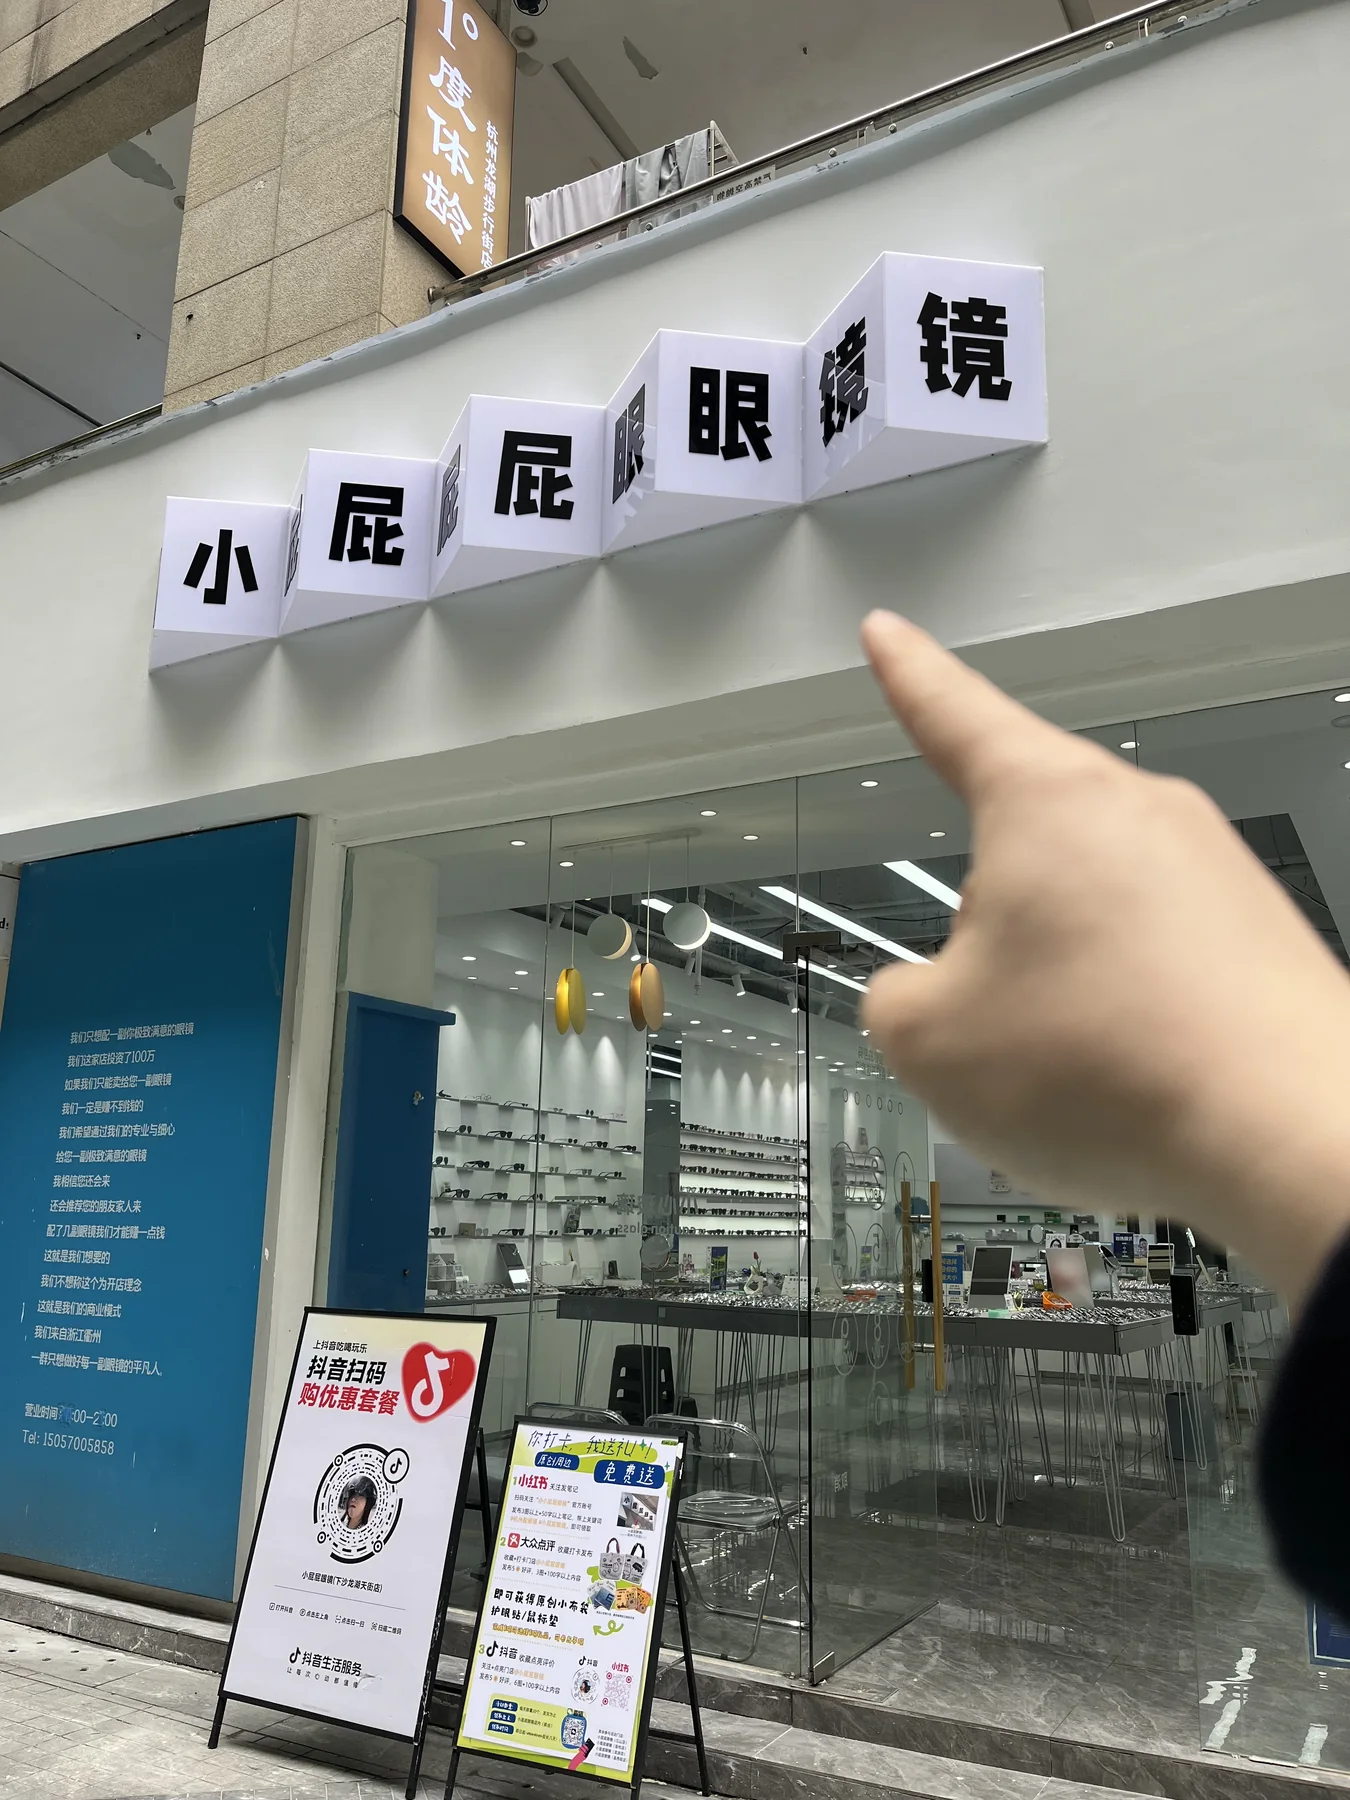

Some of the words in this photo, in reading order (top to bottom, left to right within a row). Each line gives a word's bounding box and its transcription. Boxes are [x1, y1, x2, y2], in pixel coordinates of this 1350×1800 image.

[67, 1049, 156, 1068] 我们这家店投资了100万
[63, 1072, 173, 1091] 如果我们只能卖给您一副眼镜
[61, 1098, 144, 1116] 我们一定是赚不到钱的
[58, 1122, 176, 1139] 我们希望通过我们的专业与细心
[55, 1148, 147, 1164] 给您一副极致满意的眼镜
[53, 1174, 111, 1188] 我相信您还会来
[49, 1199, 142, 1214] 还会推荐您的朋友家人来
[46, 1223, 166, 1240] 配了几副眼镜我们才能赚一点钱
[43, 1249, 111, 1265] 这就是我们想要的
[40, 1274, 142, 1293] 我们不想称这个为开店理念
[37, 1300, 122, 1318] 这就是我们的商业模式
[34, 1325, 102, 1344] 我们来自浙江衢州
[313, 1340, 368, 1354] 上抖音吃喝玩乐
[306, 1355, 388, 1385] 抖音扫码
[298, 1383, 401, 1416] 购优惠套餐
[22, 1429, 40, 1445] Tel:
[43, 1432, 115, 1455] 15057005858
[537, 1454, 572, 1468] 原创周边
[603, 1461, 655, 1485] 免费送
[518, 1473, 549, 1490] 小红书
[549, 1482, 579, 1493] 关注发笔记
[520, 1536, 556, 1552] 大众点评
[490, 1605, 559, 1627] 护眼贴/鼠标垫
[301, 1651, 363, 1677] 抖音生活服务
[499, 1645, 518, 1660] 抖音
[519, 1654, 555, 1668] 收藏点亮评价
[611, 1662, 630, 1673] 小红书
